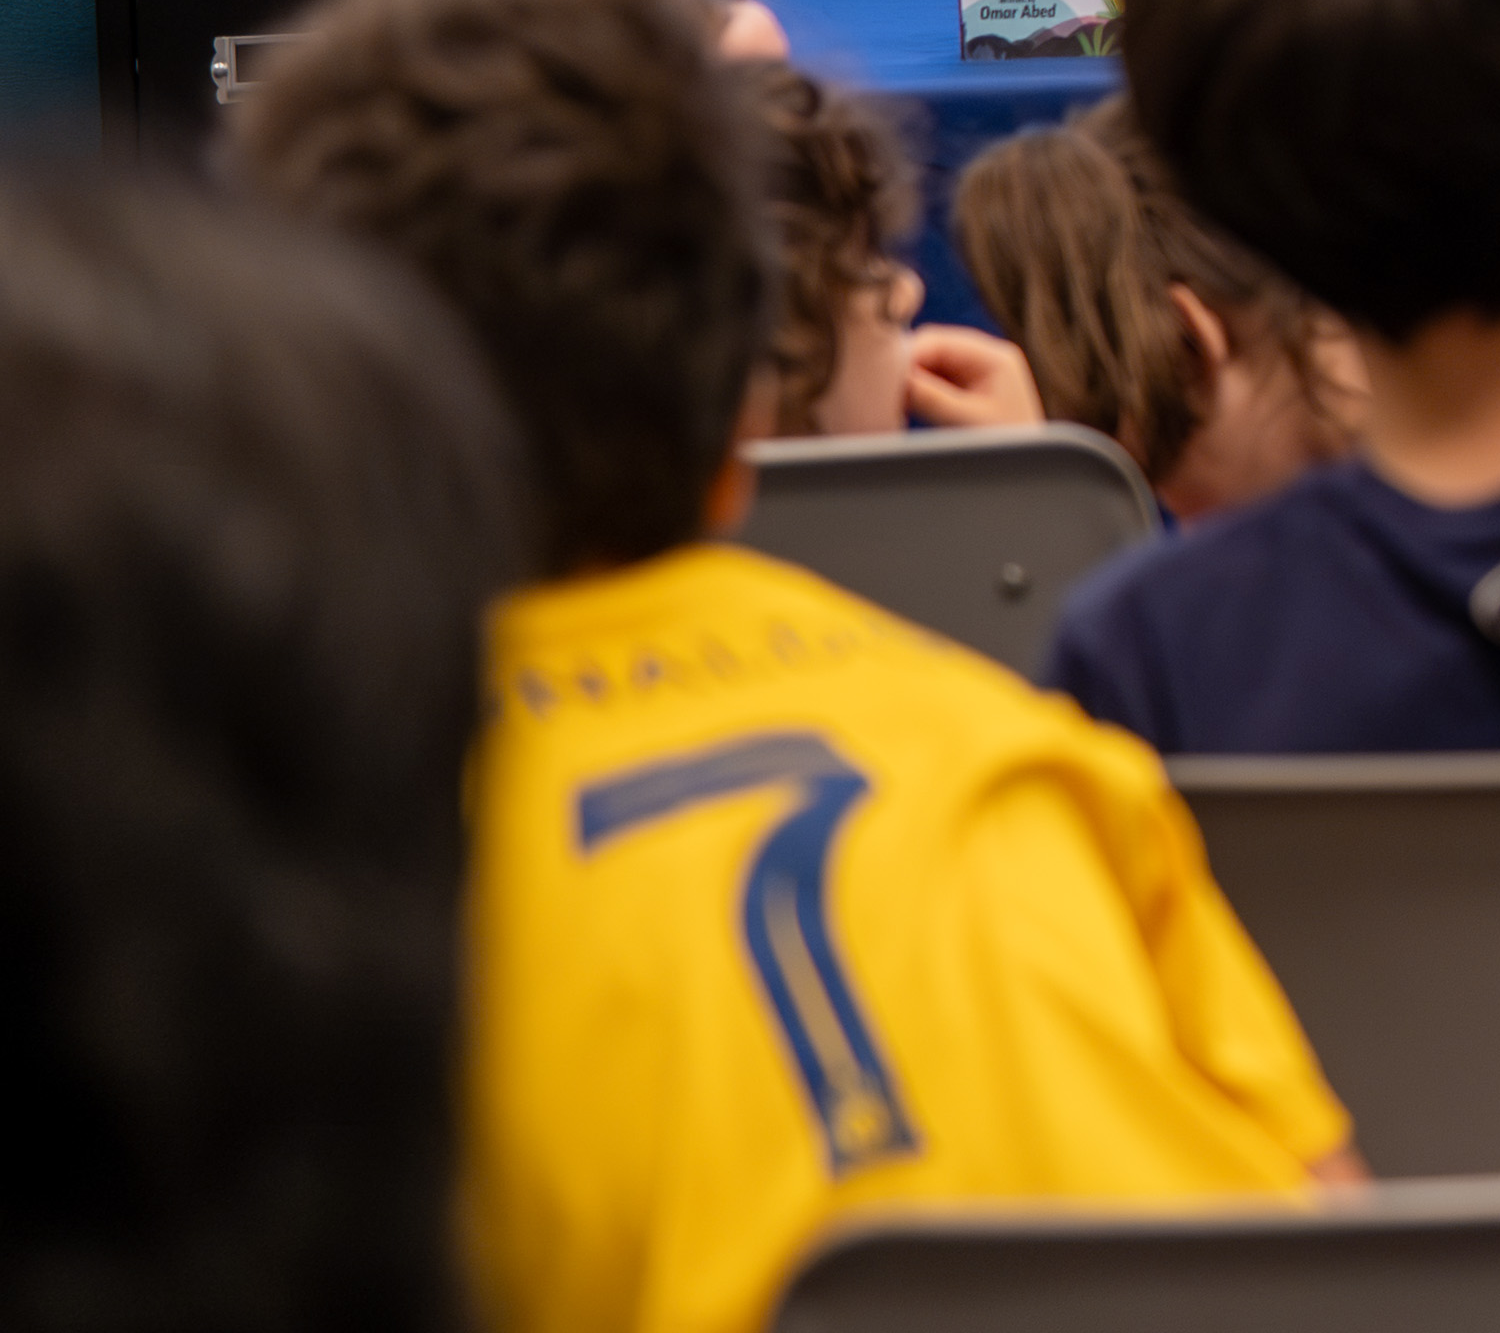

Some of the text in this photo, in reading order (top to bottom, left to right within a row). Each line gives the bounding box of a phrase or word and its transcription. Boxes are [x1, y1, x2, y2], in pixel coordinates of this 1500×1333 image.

[980, 4, 1058, 21] Omar Abed
[572, 728, 926, 1181] 7
